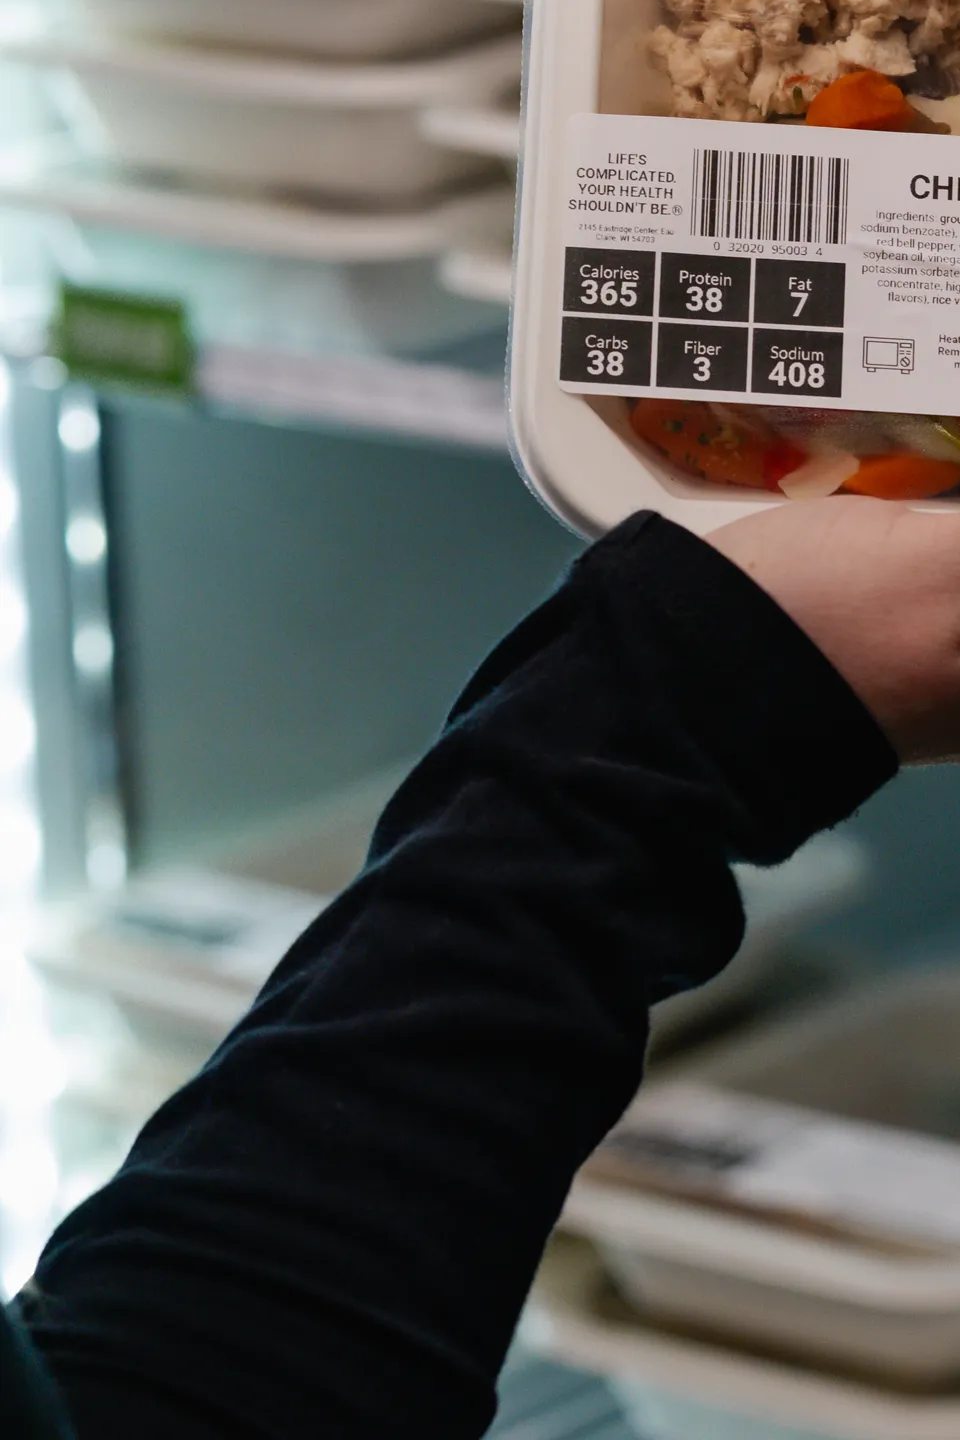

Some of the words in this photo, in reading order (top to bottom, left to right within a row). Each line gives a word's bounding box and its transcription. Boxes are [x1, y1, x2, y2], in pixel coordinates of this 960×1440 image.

[607, 152, 647, 165] LIFE'S
[576, 166, 676, 183] COMPLICATED.
[578, 183, 615, 196] YOUR
[619, 185, 673, 199] HEALTH
[567, 198, 647, 214] SHOULDN'T
[860, 222, 899, 234] sodium
[901, 224, 958, 238] benzoate),
[712, 241, 720, 251] 0
[727, 242, 764, 254] 32020
[771, 244, 808, 256] 95003
[815, 247, 822, 256] 4
[876, 237, 894, 247] red
[896, 237, 915, 248] bell
[917, 241, 956, 252] pepper,
[862, 249, 909, 262] soybean
[909, 251, 925, 263] oil,
[579, 263, 639, 279] Calories
[679, 269, 732, 285] Protein
[861, 264, 918, 275] potassium
[919, 266, 960, 278] sorbate
[788, 276, 812, 291] Fat
[877, 279, 943, 291] concentrate,
[579, 279, 637, 307] 365
[685, 285, 722, 313] 38
[887, 291, 929, 304] flavors),
[931, 296, 952, 305] rice
[790, 291, 809, 317] 7
[584, 334, 628, 350] Carbs
[684, 340, 722, 356] Fiber
[770, 345, 824, 362] Sodium
[586, 349, 624, 376] 38
[692, 356, 711, 382] 3
[767, 361, 825, 388] 408
